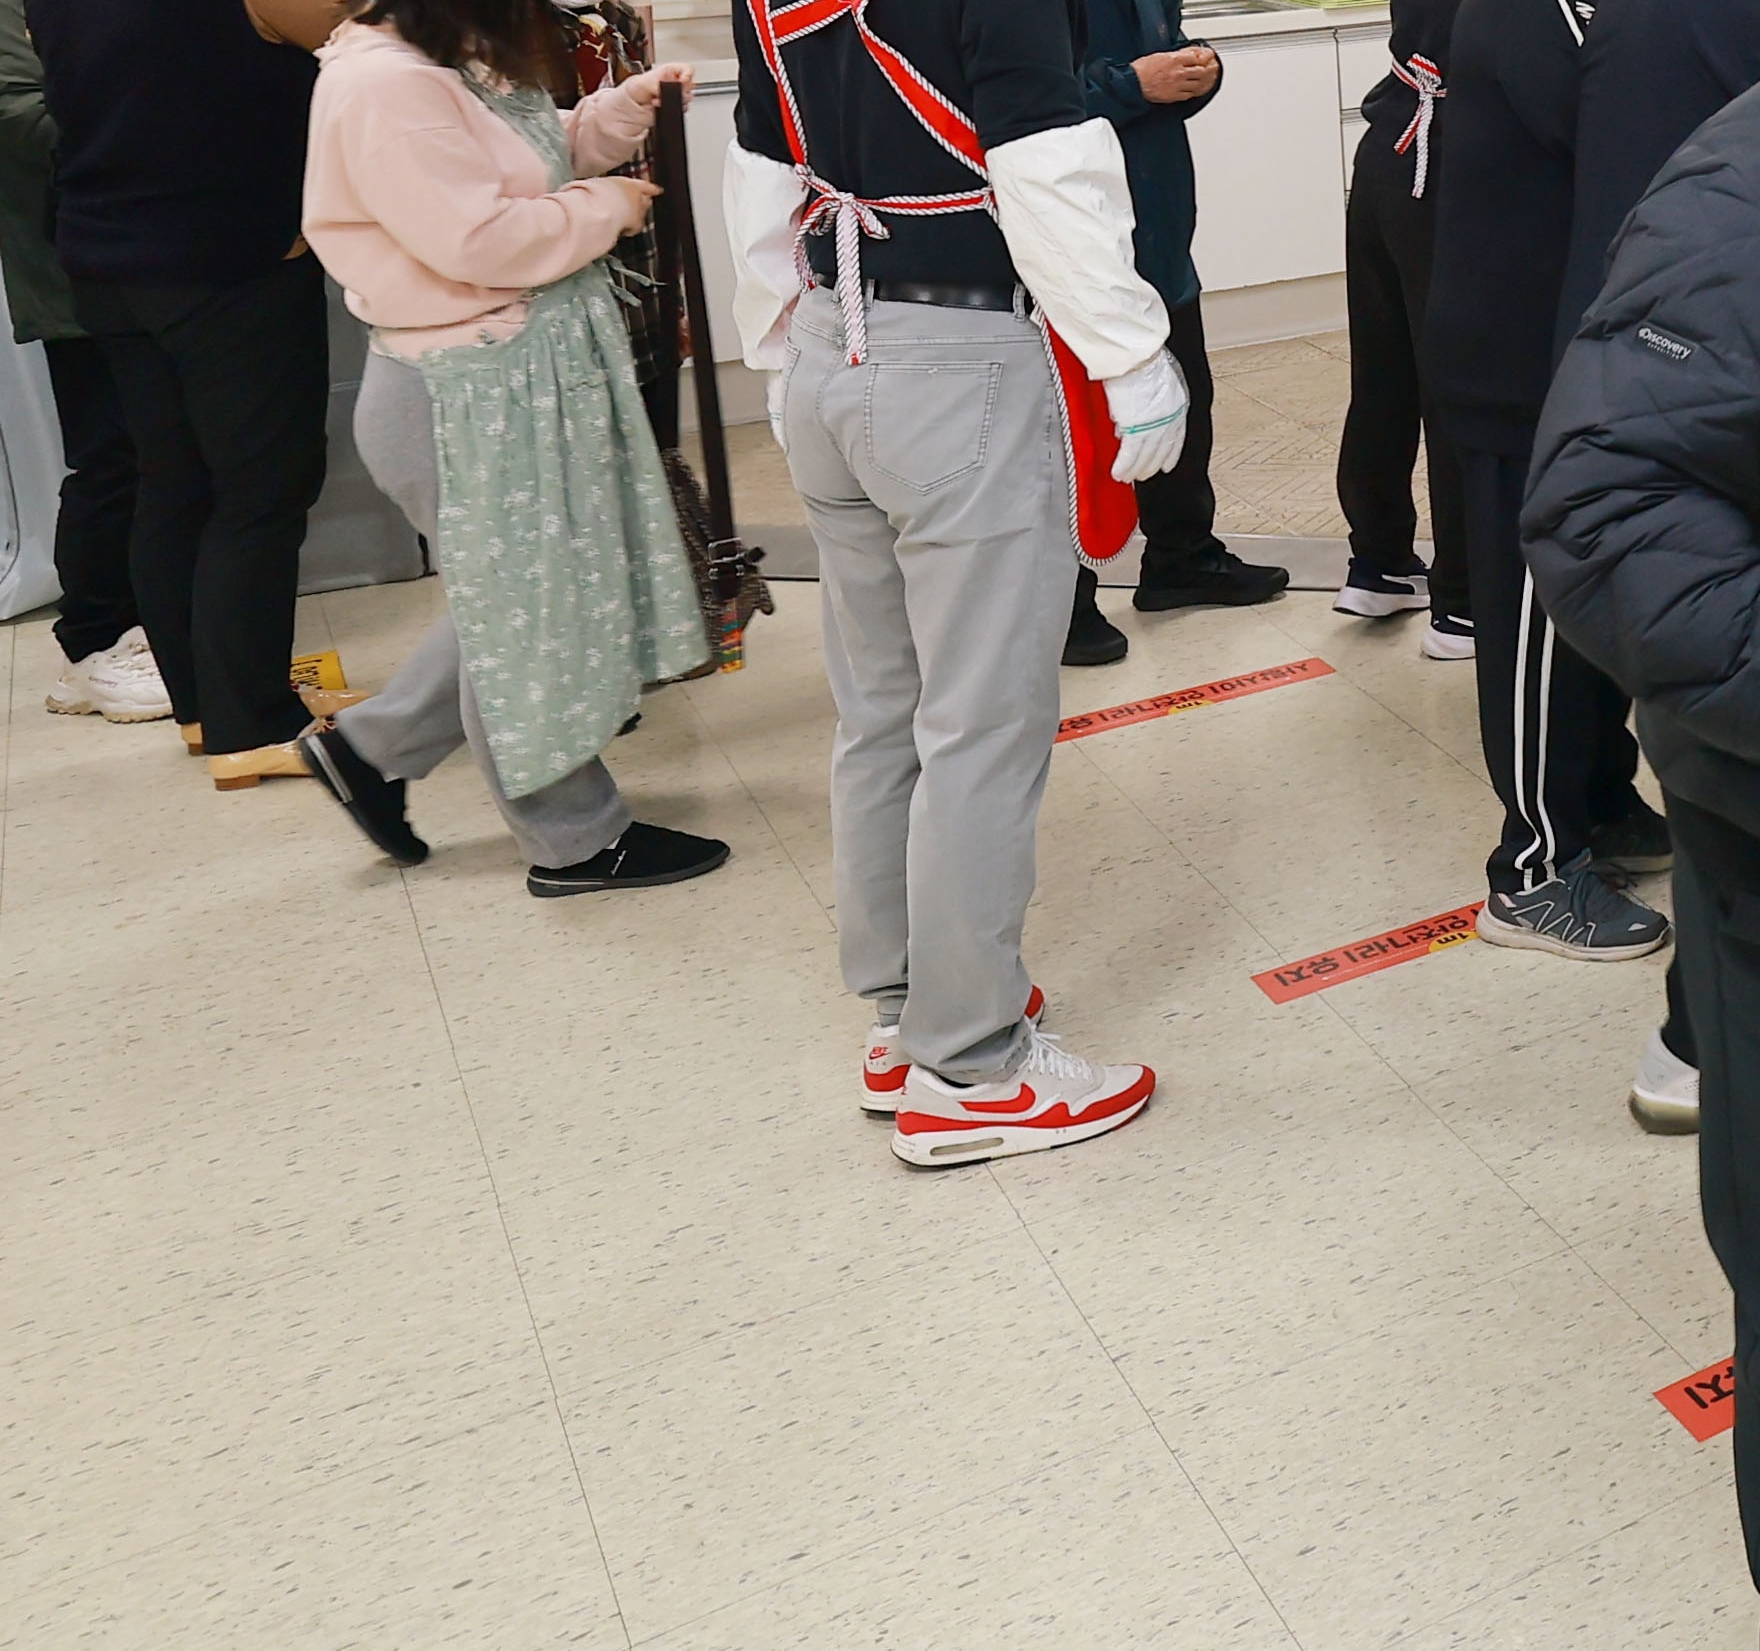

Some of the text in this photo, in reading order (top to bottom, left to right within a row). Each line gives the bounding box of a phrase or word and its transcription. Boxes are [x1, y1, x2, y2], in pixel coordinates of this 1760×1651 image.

[1274, 914, 1470, 986] 안전거리 유지
[1435, 933, 1470, 945] 1m
[1684, 1366, 1735, 1409] 지
